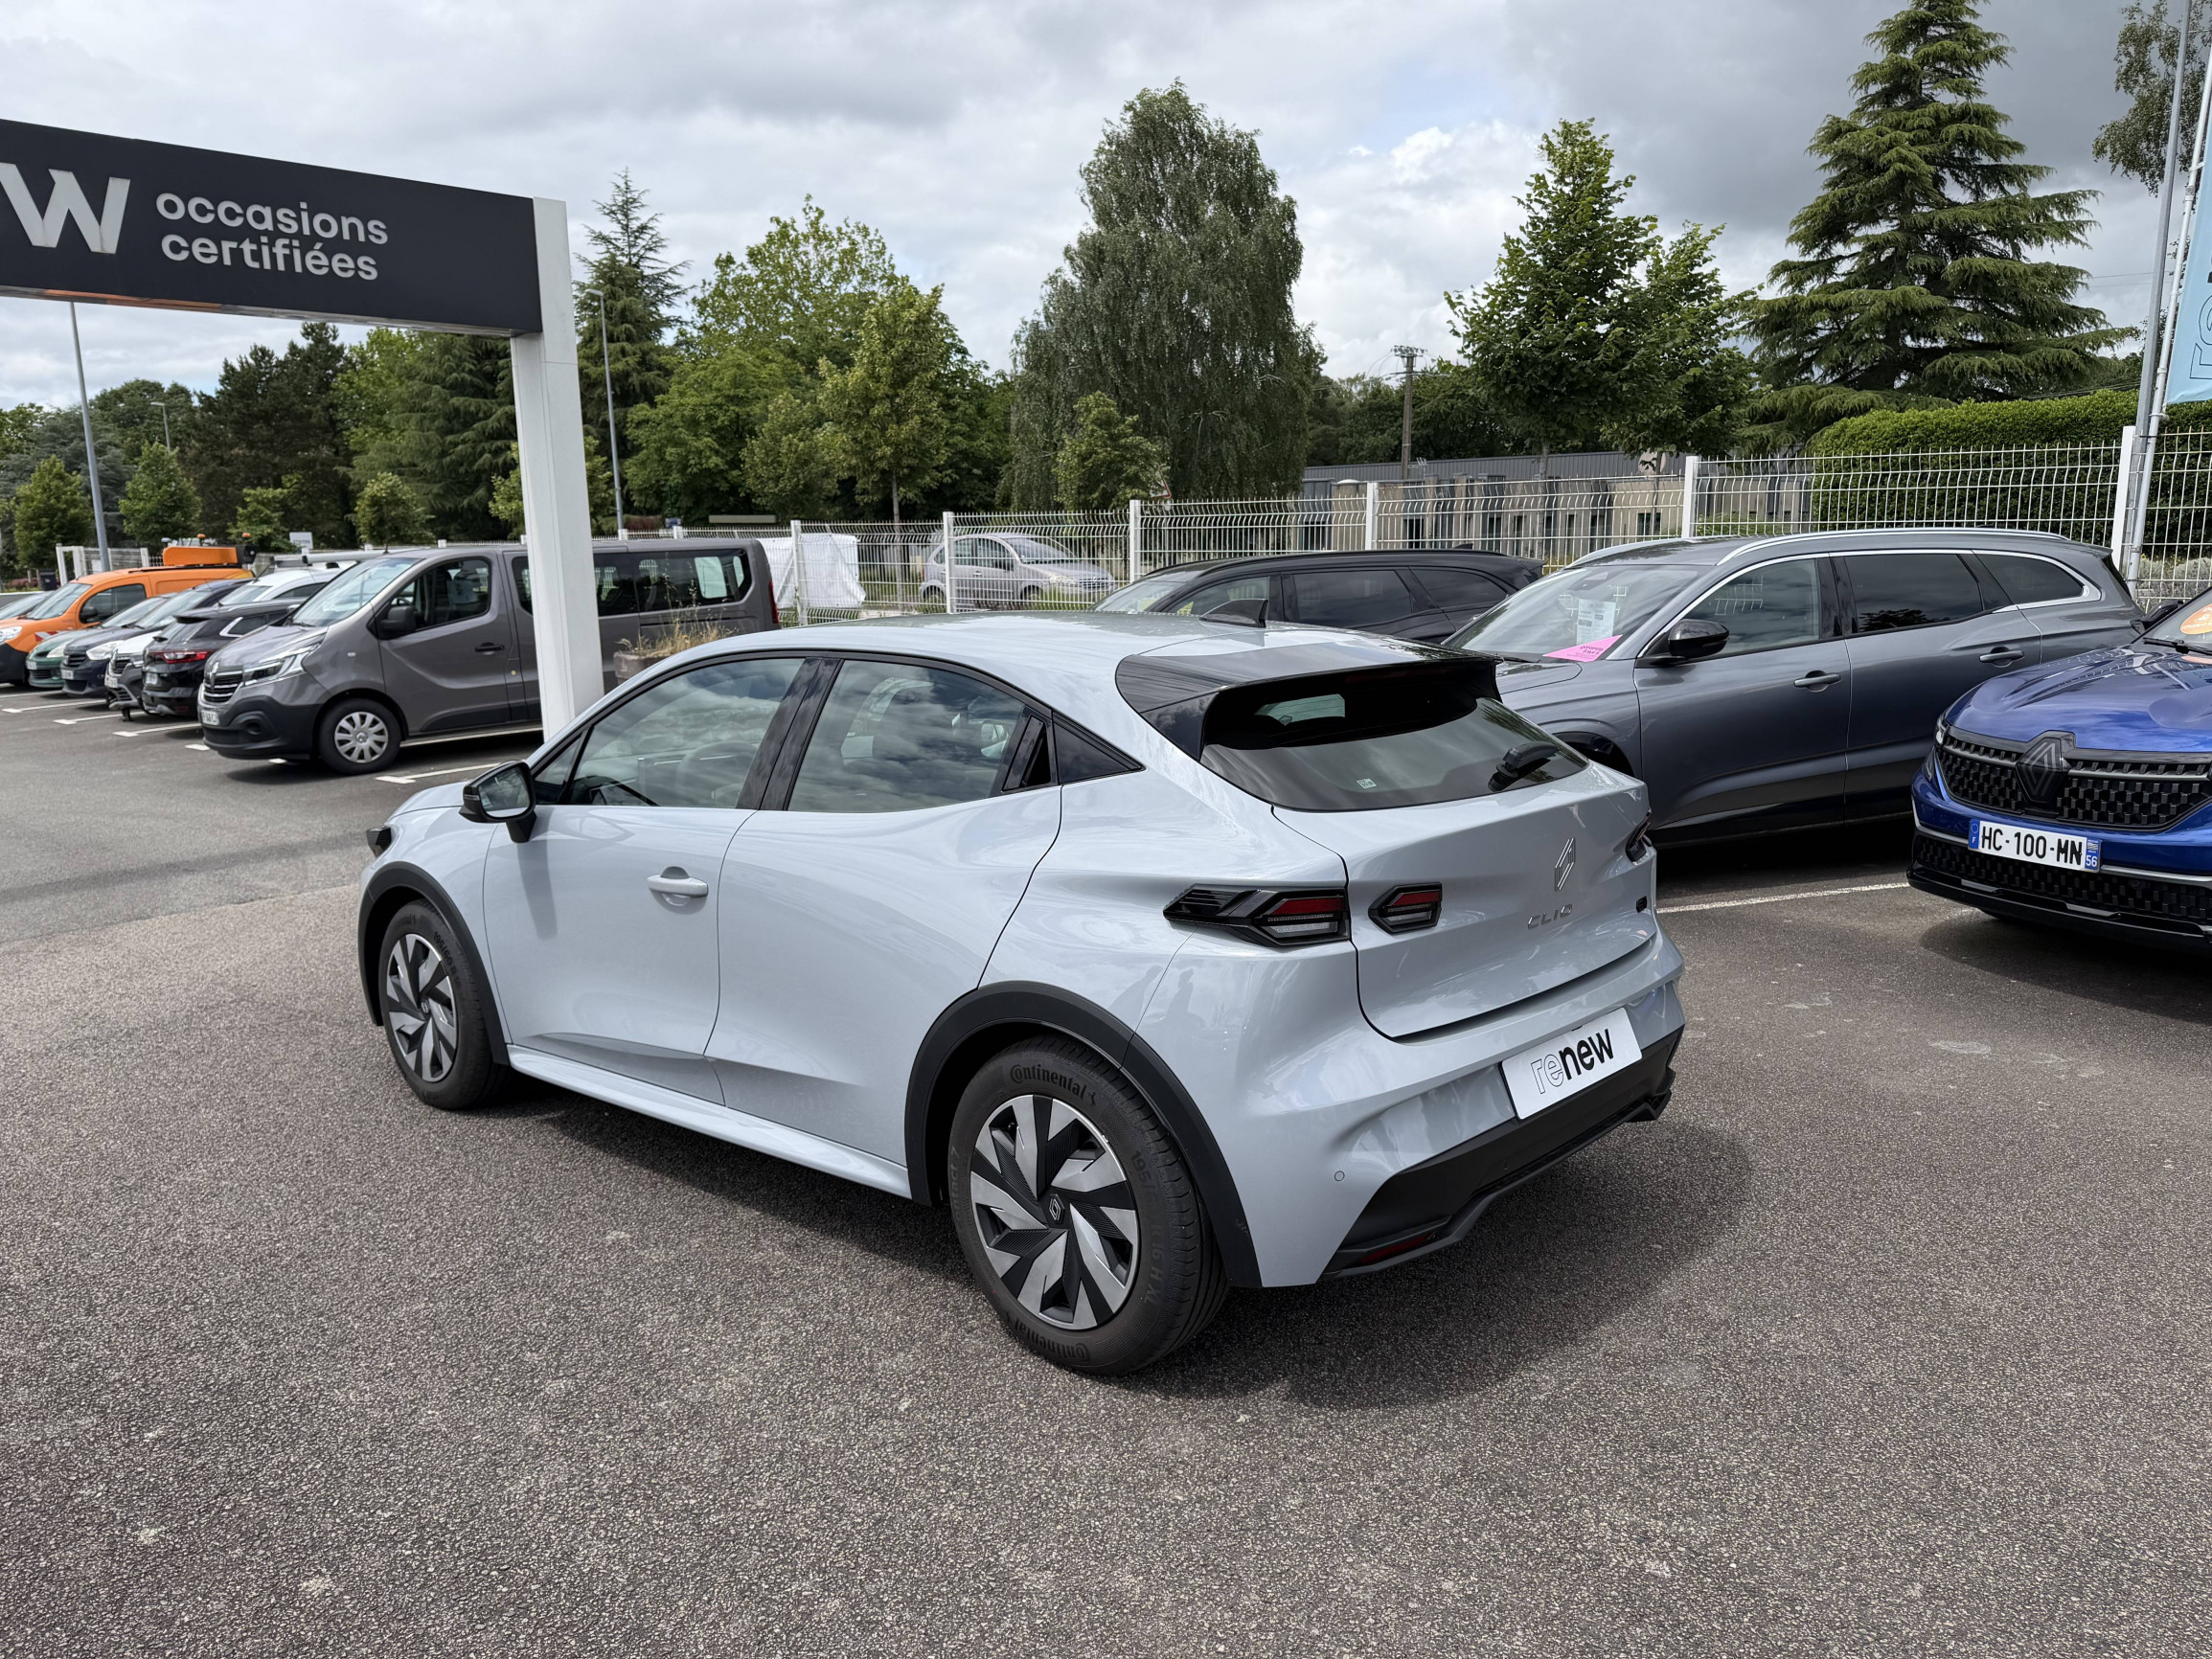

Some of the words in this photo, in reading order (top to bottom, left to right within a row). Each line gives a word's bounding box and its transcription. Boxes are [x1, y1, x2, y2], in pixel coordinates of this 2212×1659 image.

[155, 192, 389, 245] occasions
[160, 233, 379, 281] certifiées
[1981, 826, 2083, 866] HC-100-MN
[2086, 854, 2098, 867] 56
[1527, 903, 1573, 929] CLIO
[1010, 1062, 1087, 1101] Continental
[1530, 1028, 1615, 1095] renew
